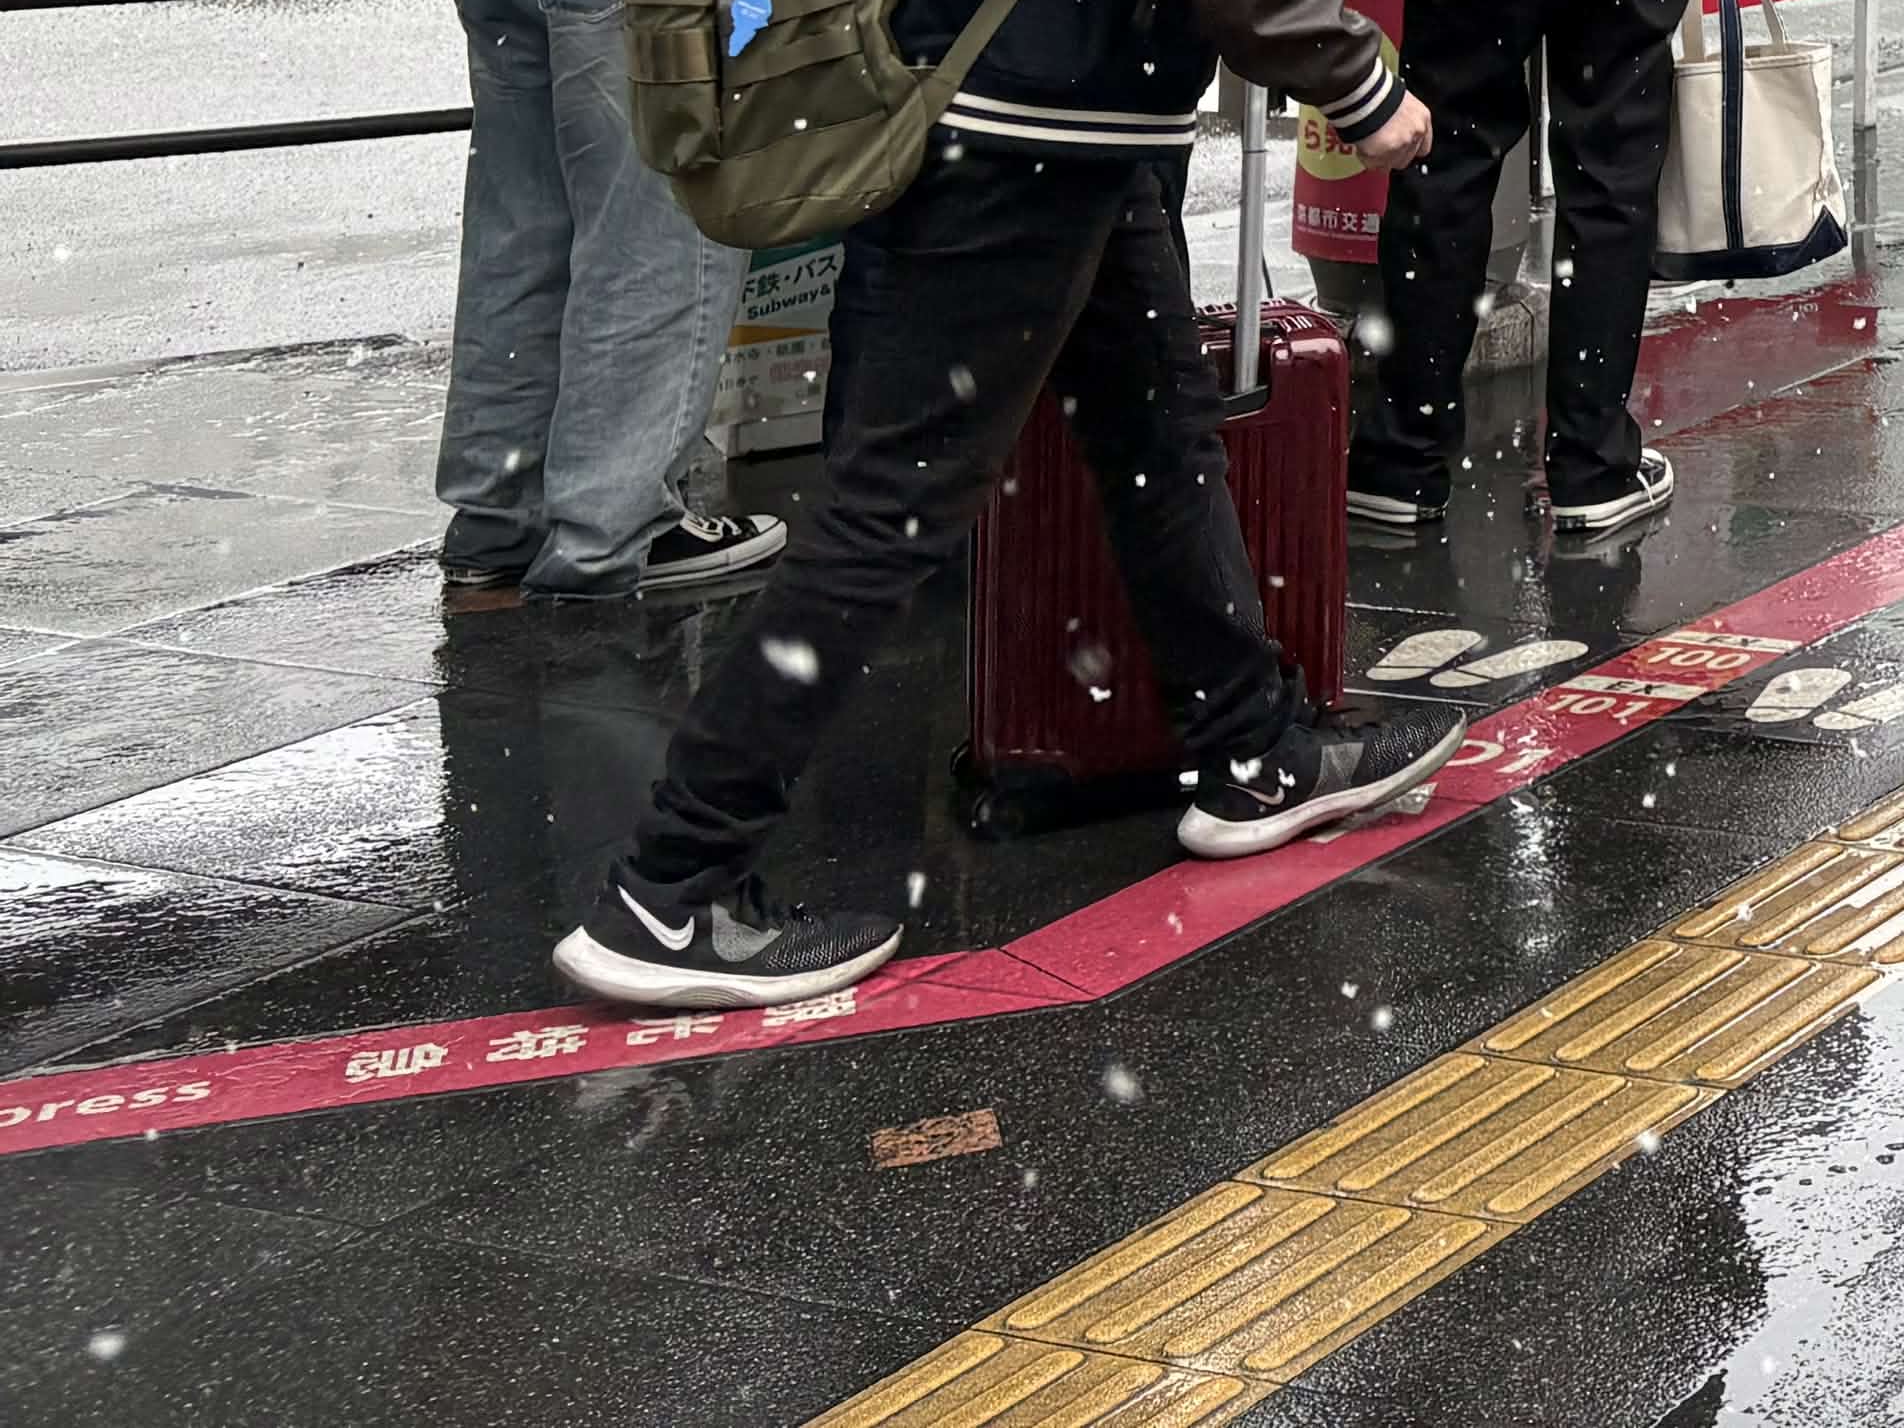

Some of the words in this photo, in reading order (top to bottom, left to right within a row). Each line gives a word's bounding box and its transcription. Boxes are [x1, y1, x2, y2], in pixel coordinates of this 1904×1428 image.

[1648, 647, 1751, 671] 100
[1605, 680, 1665, 694] EX
[1546, 693, 1649, 721] 101
